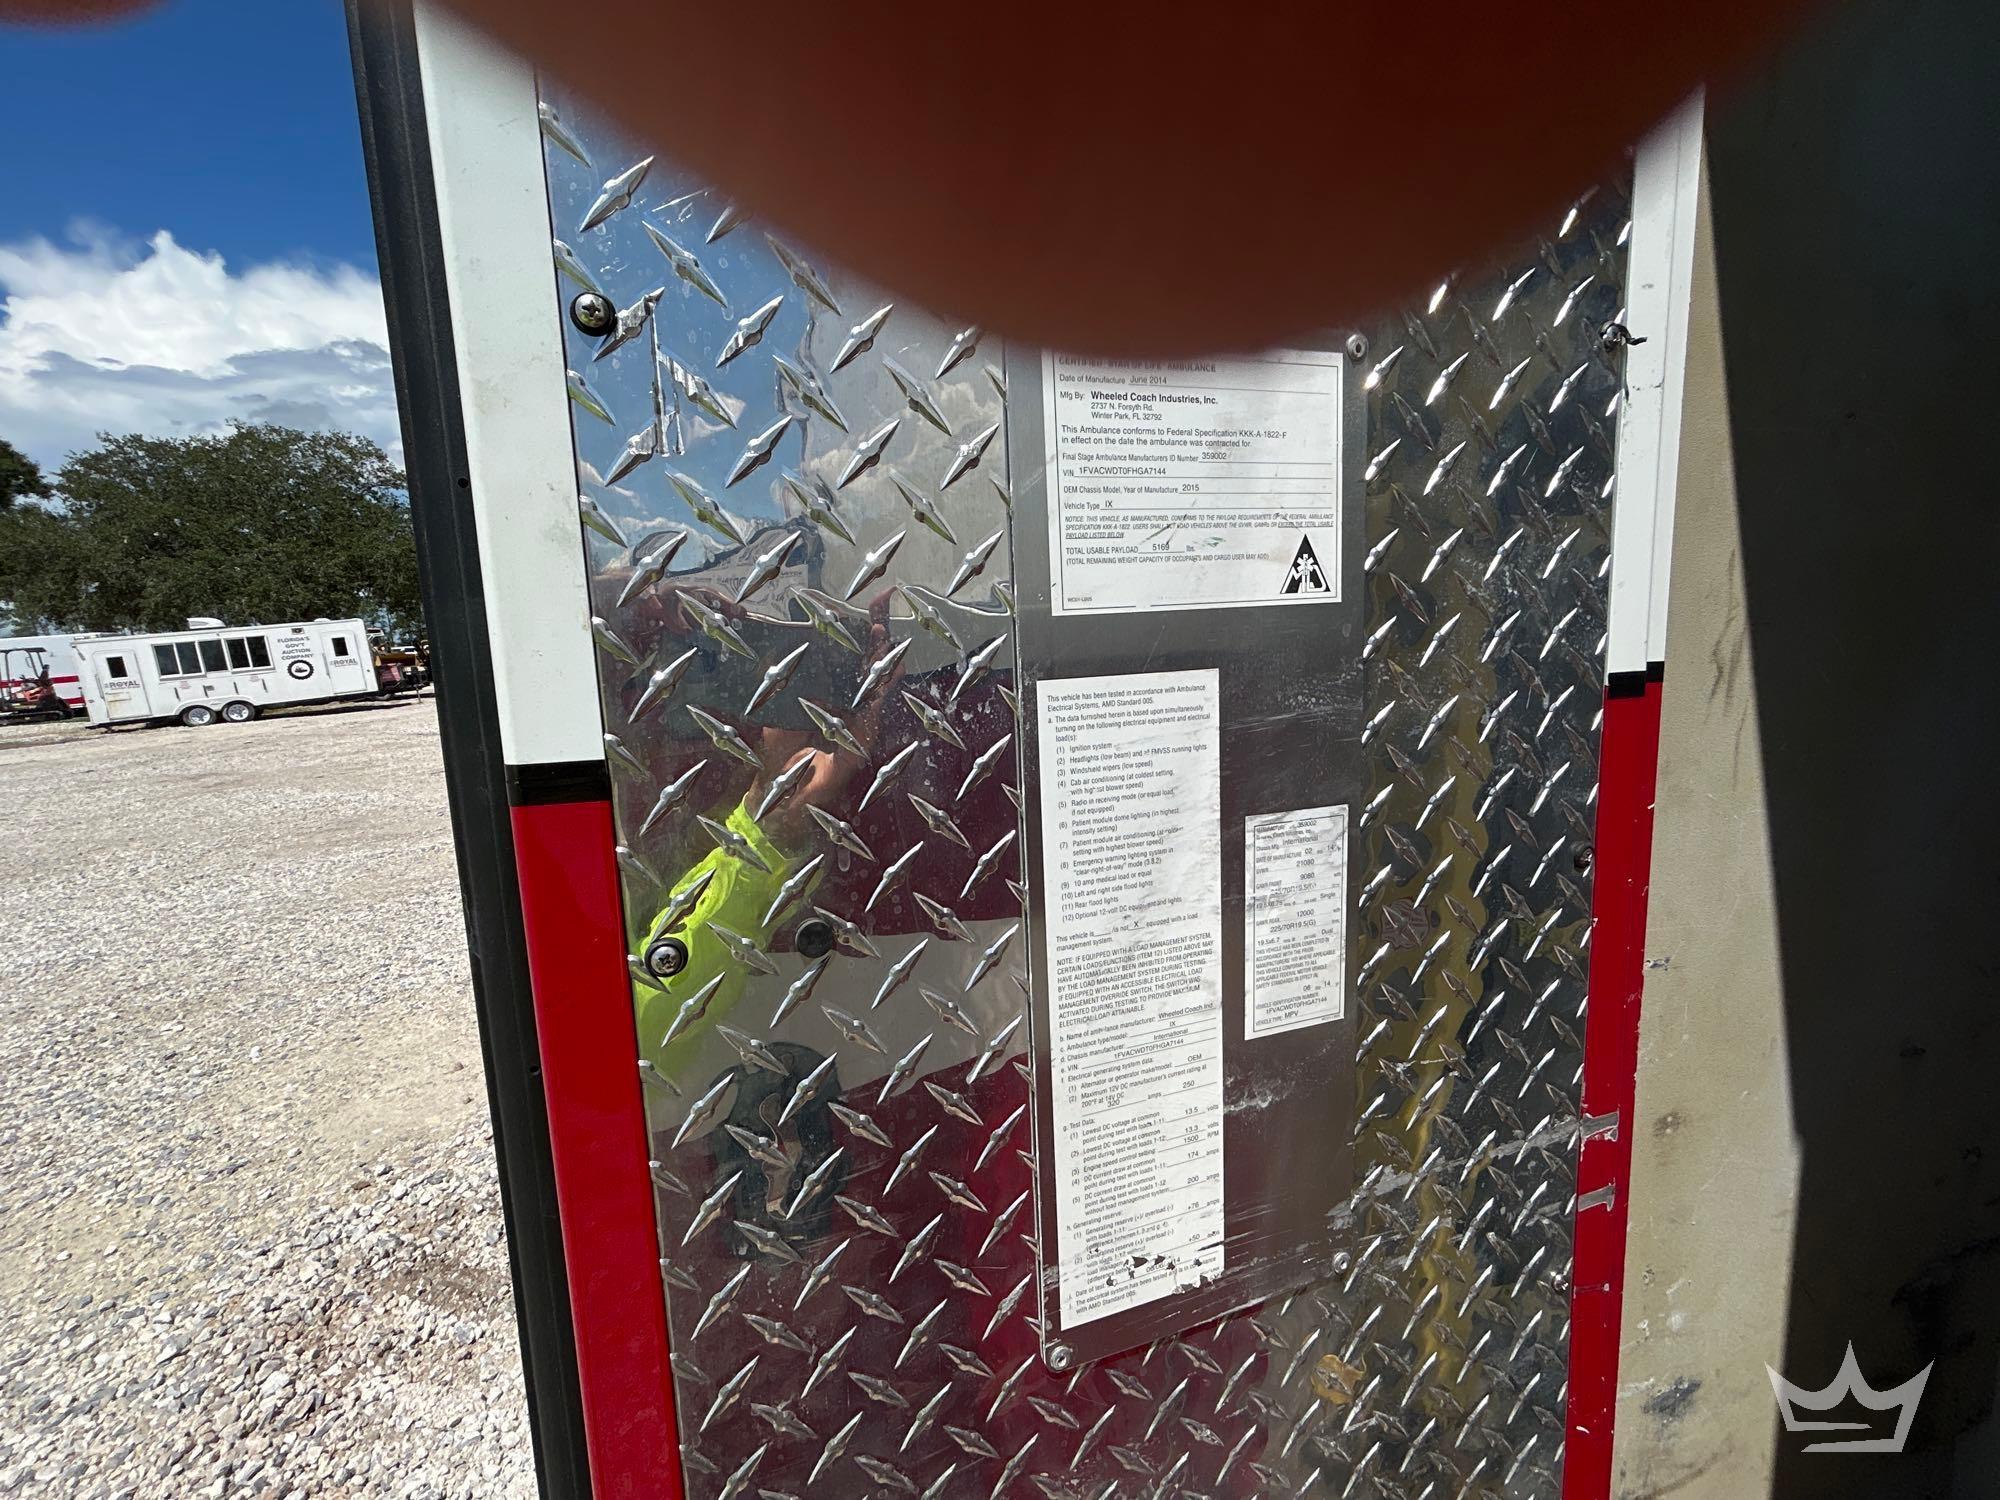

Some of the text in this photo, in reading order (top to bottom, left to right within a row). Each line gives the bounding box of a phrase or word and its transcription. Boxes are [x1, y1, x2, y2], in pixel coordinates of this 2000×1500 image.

[1058, 374, 1167, 384] Date of Manufacture June 2014
[1090, 390, 1128, 401] Wheeled
[1129, 392, 1156, 402] Coach
[1158, 393, 1202, 406] Industries,
[1203, 395, 1219, 404] Inc.
[1090, 402, 1107, 410] 2737
[1117, 403, 1141, 412] Forsyth
[1091, 411, 1112, 419] Winter
[1113, 412, 1130, 421] Park,
[1131, 412, 1141, 420] FL
[1061, 425, 1078, 433] This
[1079, 425, 1121, 434] Ambulance
[1122, 426, 1156, 435] conforms
[1157, 427, 1164, 435] to
[1166, 428, 1193, 436] Federal
[1194, 428, 1237, 439] Specification
[1061, 435, 1068, 443] in
[1070, 436, 1091, 444] effect
[1104, 436, 1116, 444] the
[1117, 436, 1134, 445] date
[1135, 437, 1148, 445] the
[1149, 437, 1187, 446] ambulance
[1204, 438, 1240, 446] contracted
[1077, 453, 1094, 462] Stage
[1095, 453, 1127, 461] Ambulance
[1127, 453, 1168, 461] Manufacturers
[1176, 454, 1198, 462] Number
[1201, 452, 1227, 460] 359002
[1079, 467, 1166, 475] 1FVACWDT0FHGA7144
[1144, 486, 1178, 494] Manufacture
[1086, 503, 1101, 511] Type
[1112, 546, 1138, 554] PAYLOAD
[110, 680, 139, 688] ROYAL
[1060, 693, 1080, 701] vehicle
[1092, 691, 1107, 699] been
[1107, 690, 1125, 698] tested
[1132, 687, 1163, 696] accordance
[1176, 684, 1206, 693] Ambulance
[1056, 760, 1153, 777] (3) Windshield wipers (low speed)
[1297, 909, 1314, 917] 12000
[1284, 1010, 1299, 1018] MPV
[1182, 1080, 1195, 1089] 250
[1184, 1134, 1199, 1143] 1500
[1187, 1150, 1199, 1159] 174
